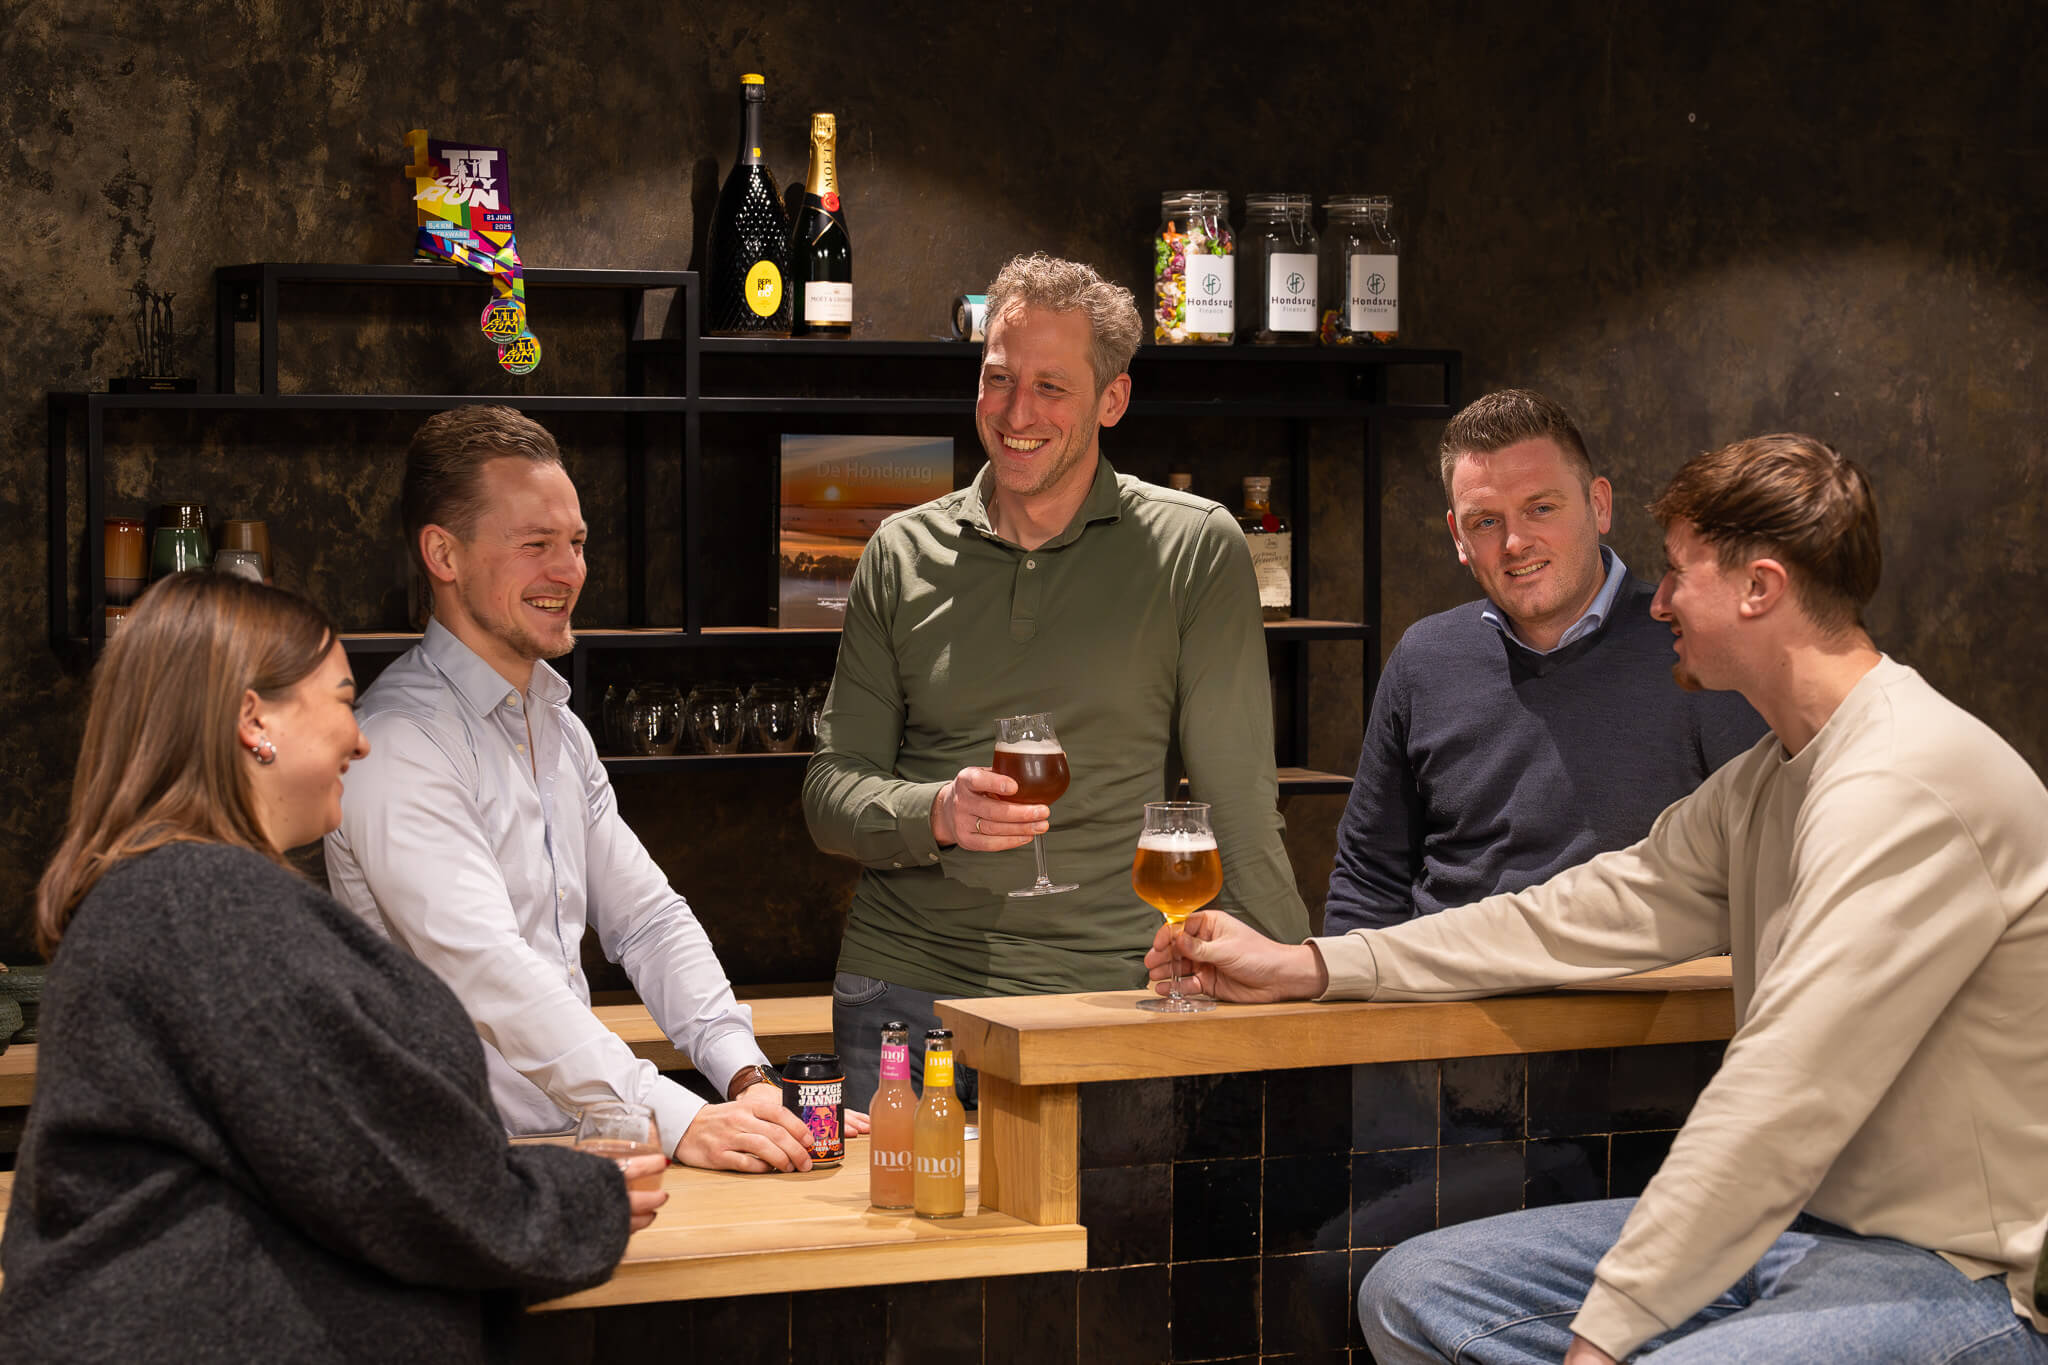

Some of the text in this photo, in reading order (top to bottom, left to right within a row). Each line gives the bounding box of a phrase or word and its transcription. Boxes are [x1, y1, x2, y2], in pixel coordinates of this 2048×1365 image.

[441, 150, 498, 178] TT
[435, 176, 497, 189] CITY
[413, 187, 500, 210] RUN
[1187, 298, 1233, 308] Hondsrug
[1271, 296, 1317, 307] Hondsrug
[1352, 297, 1397, 307] Hondsrug
[494, 309, 517, 321] TT
[485, 325, 517, 333] RUN
[502, 355, 533, 363] RUN
[816, 461, 933, 484] De Hondsrug
[798, 1083, 842, 1095] JIPPIGE
[798, 1094, 842, 1106] JANNIE
[874, 1150, 913, 1171] mo
[917, 1150, 961, 1178] moj
